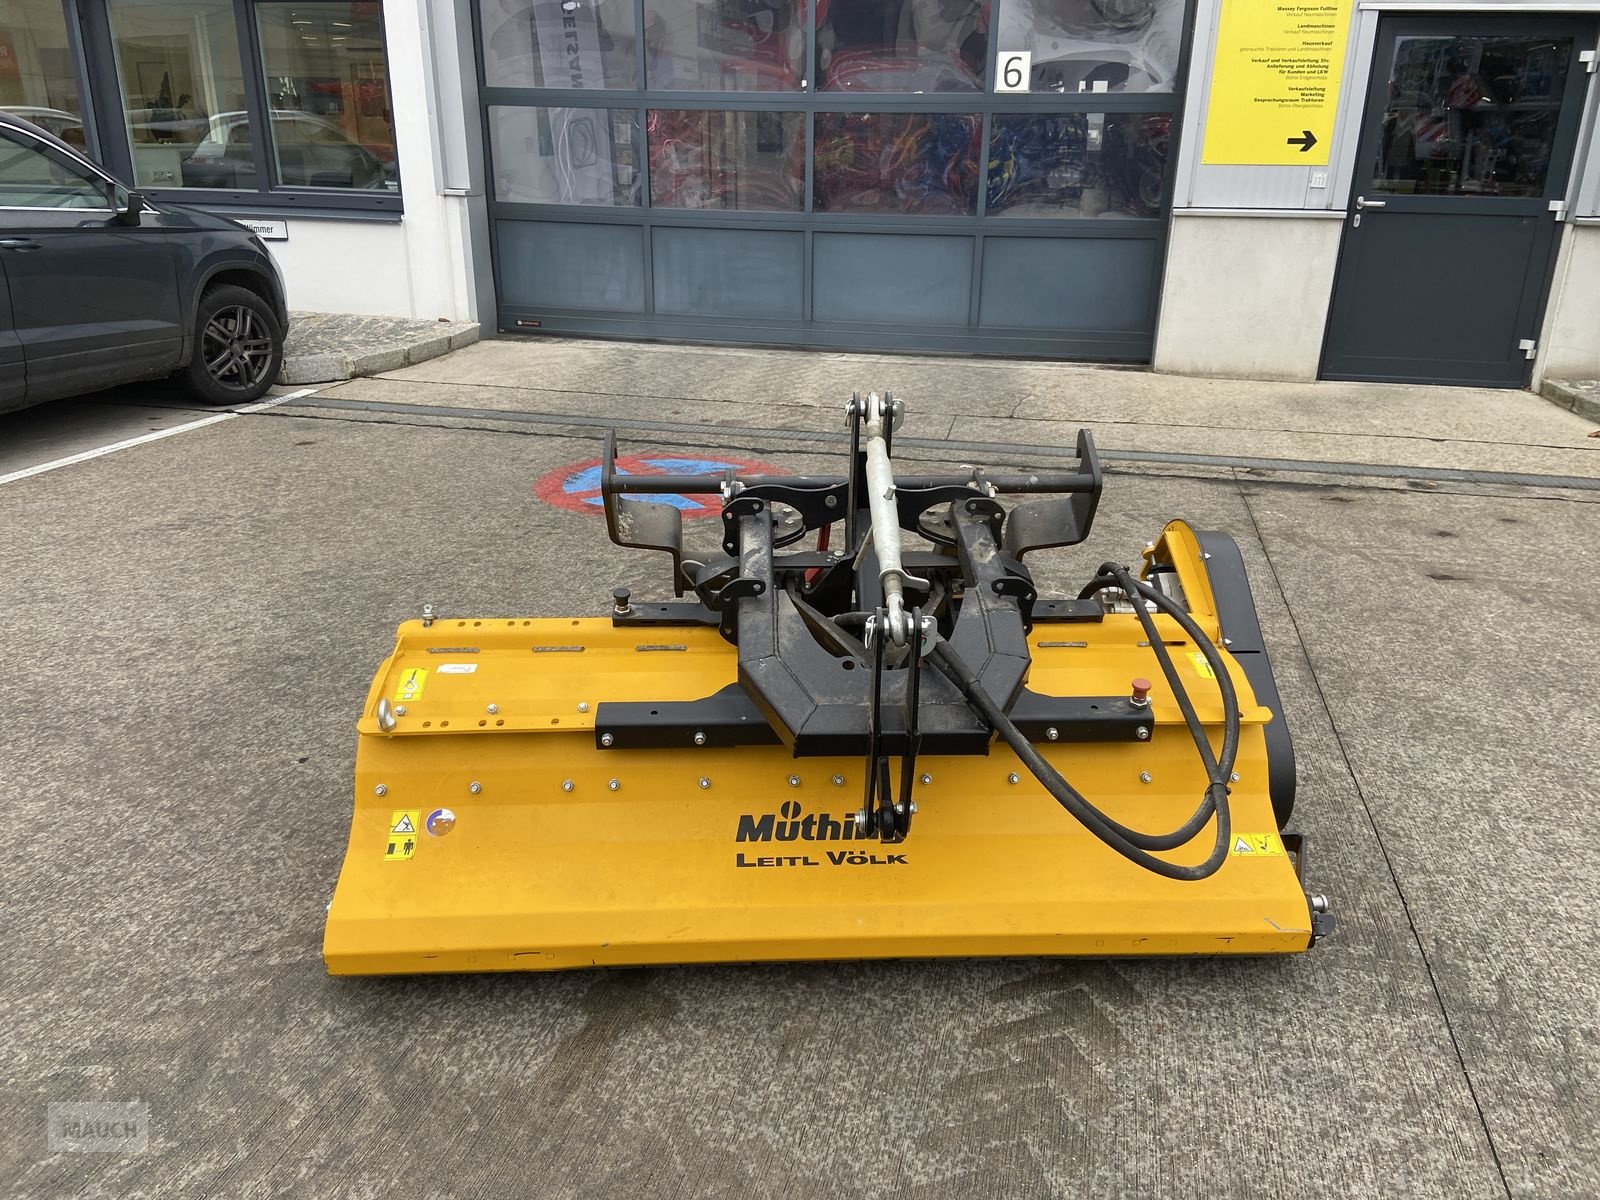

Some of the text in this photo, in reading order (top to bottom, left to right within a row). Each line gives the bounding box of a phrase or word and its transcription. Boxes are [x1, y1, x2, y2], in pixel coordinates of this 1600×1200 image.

[1004, 56, 1022, 88] 6
[735, 800, 905, 844] Müthi
[736, 850, 909, 868] LEITL VÖLK
